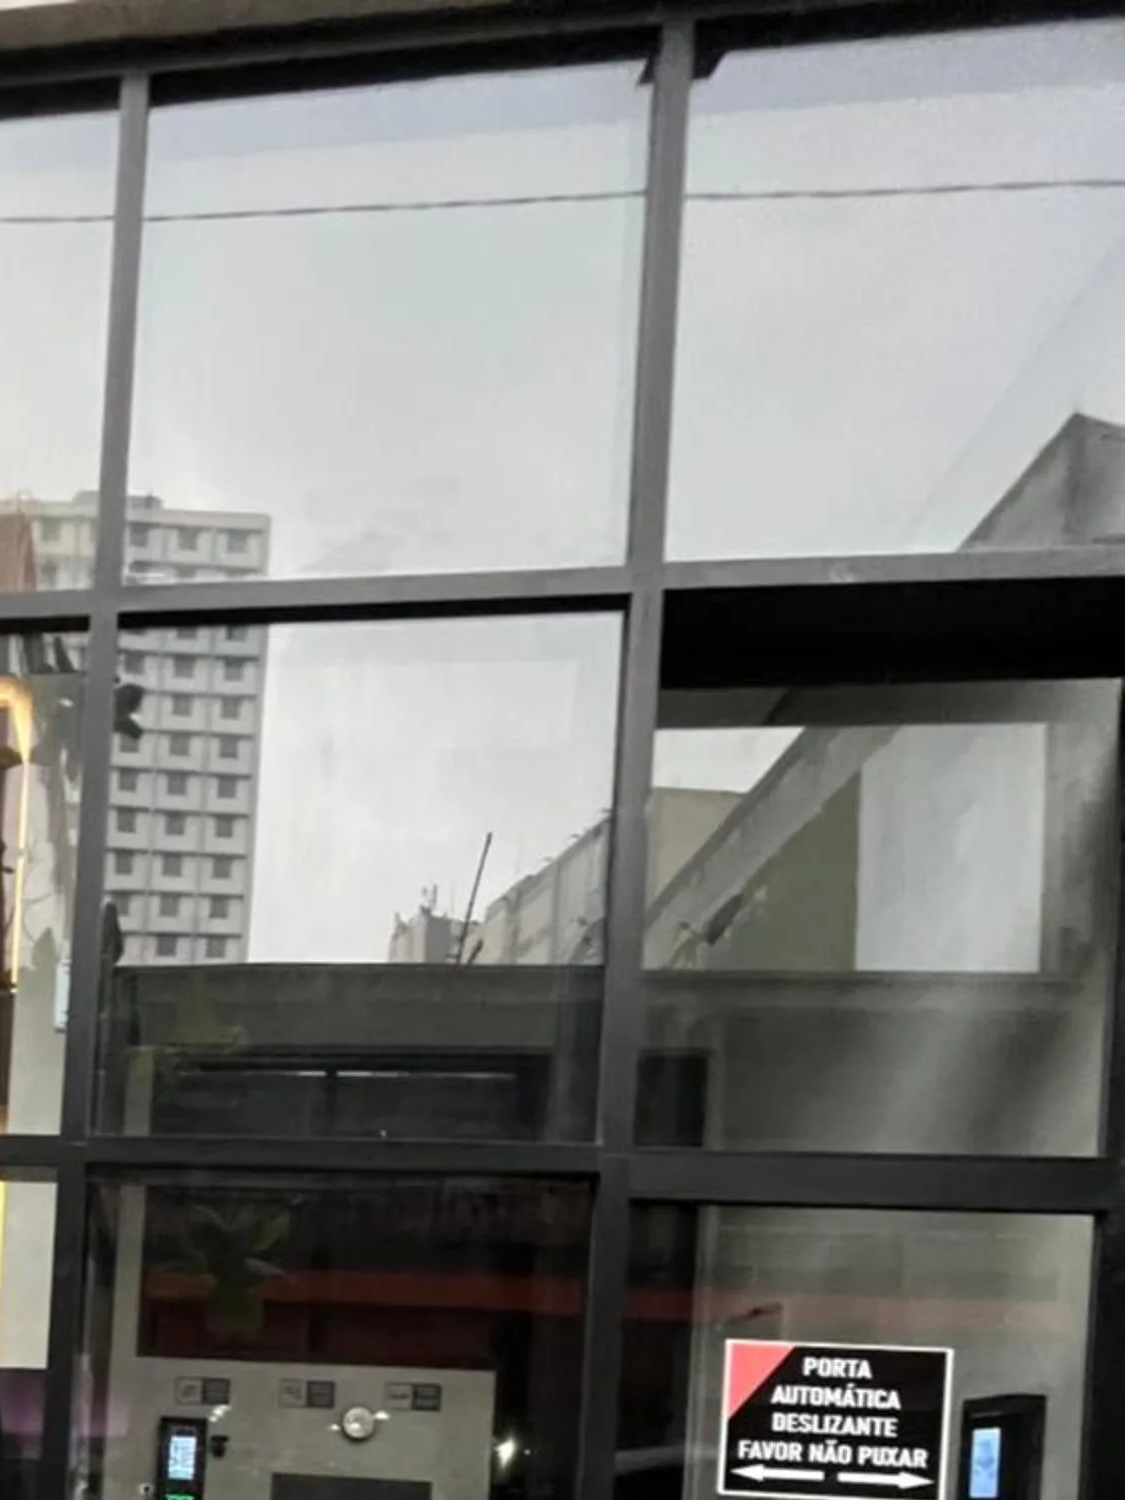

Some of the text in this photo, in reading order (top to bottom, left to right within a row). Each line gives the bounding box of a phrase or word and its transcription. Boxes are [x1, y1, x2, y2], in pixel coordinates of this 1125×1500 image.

[802, 1356, 873, 1379] PORTA
[770, 1382, 902, 1410] AUTOMÁTICA
[771, 1412, 899, 1437] DESLIZANTE
[737, 1439, 929, 1469] FAVOR NÃO PUXAR
